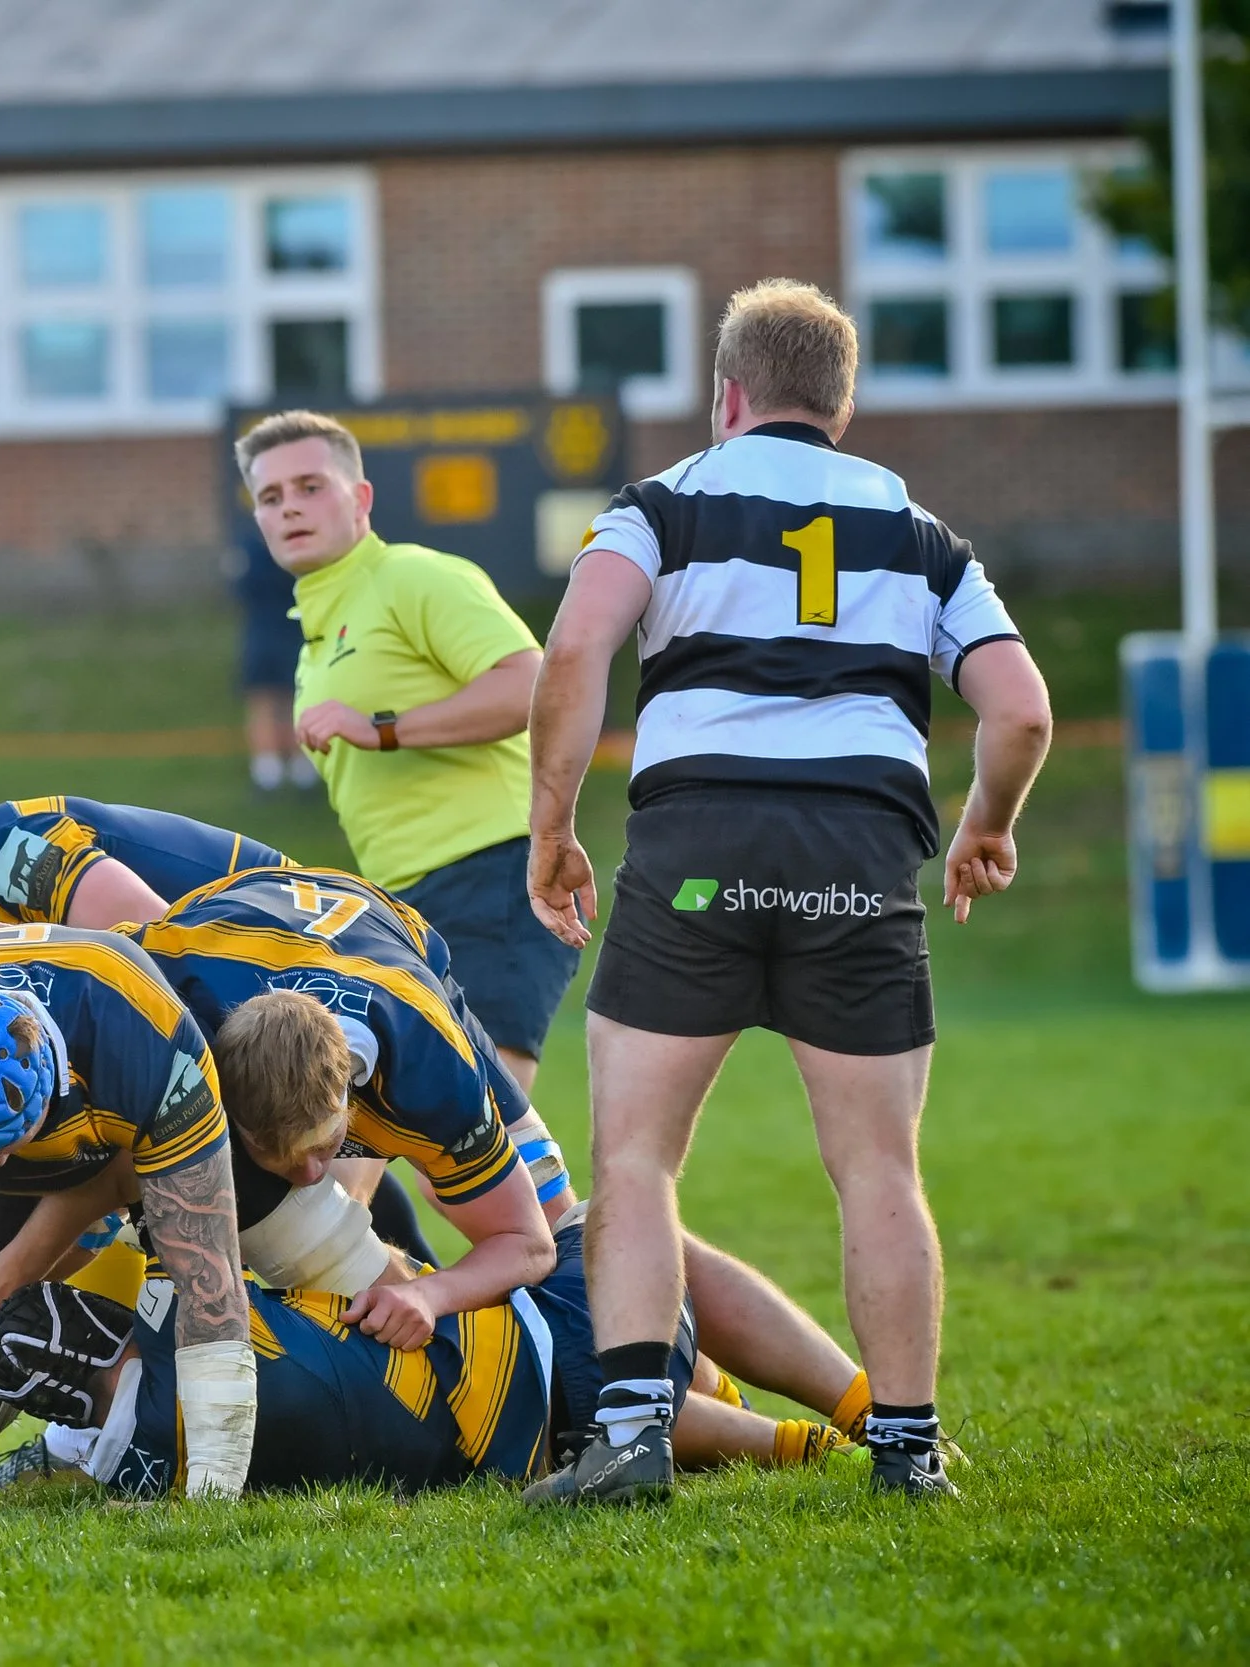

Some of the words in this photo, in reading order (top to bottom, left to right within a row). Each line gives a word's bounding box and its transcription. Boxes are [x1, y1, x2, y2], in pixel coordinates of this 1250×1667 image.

[782, 514, 839, 627] 1
[279, 878, 370, 941] 4
[723, 878, 883, 921] shawgibbs
[306, 970, 336, 979] GLOBAL
[153, 1119, 183, 1139] CHRIS
[182, 1090, 209, 1120] POTTER
[579, 1444, 651, 1495] KOOGA
